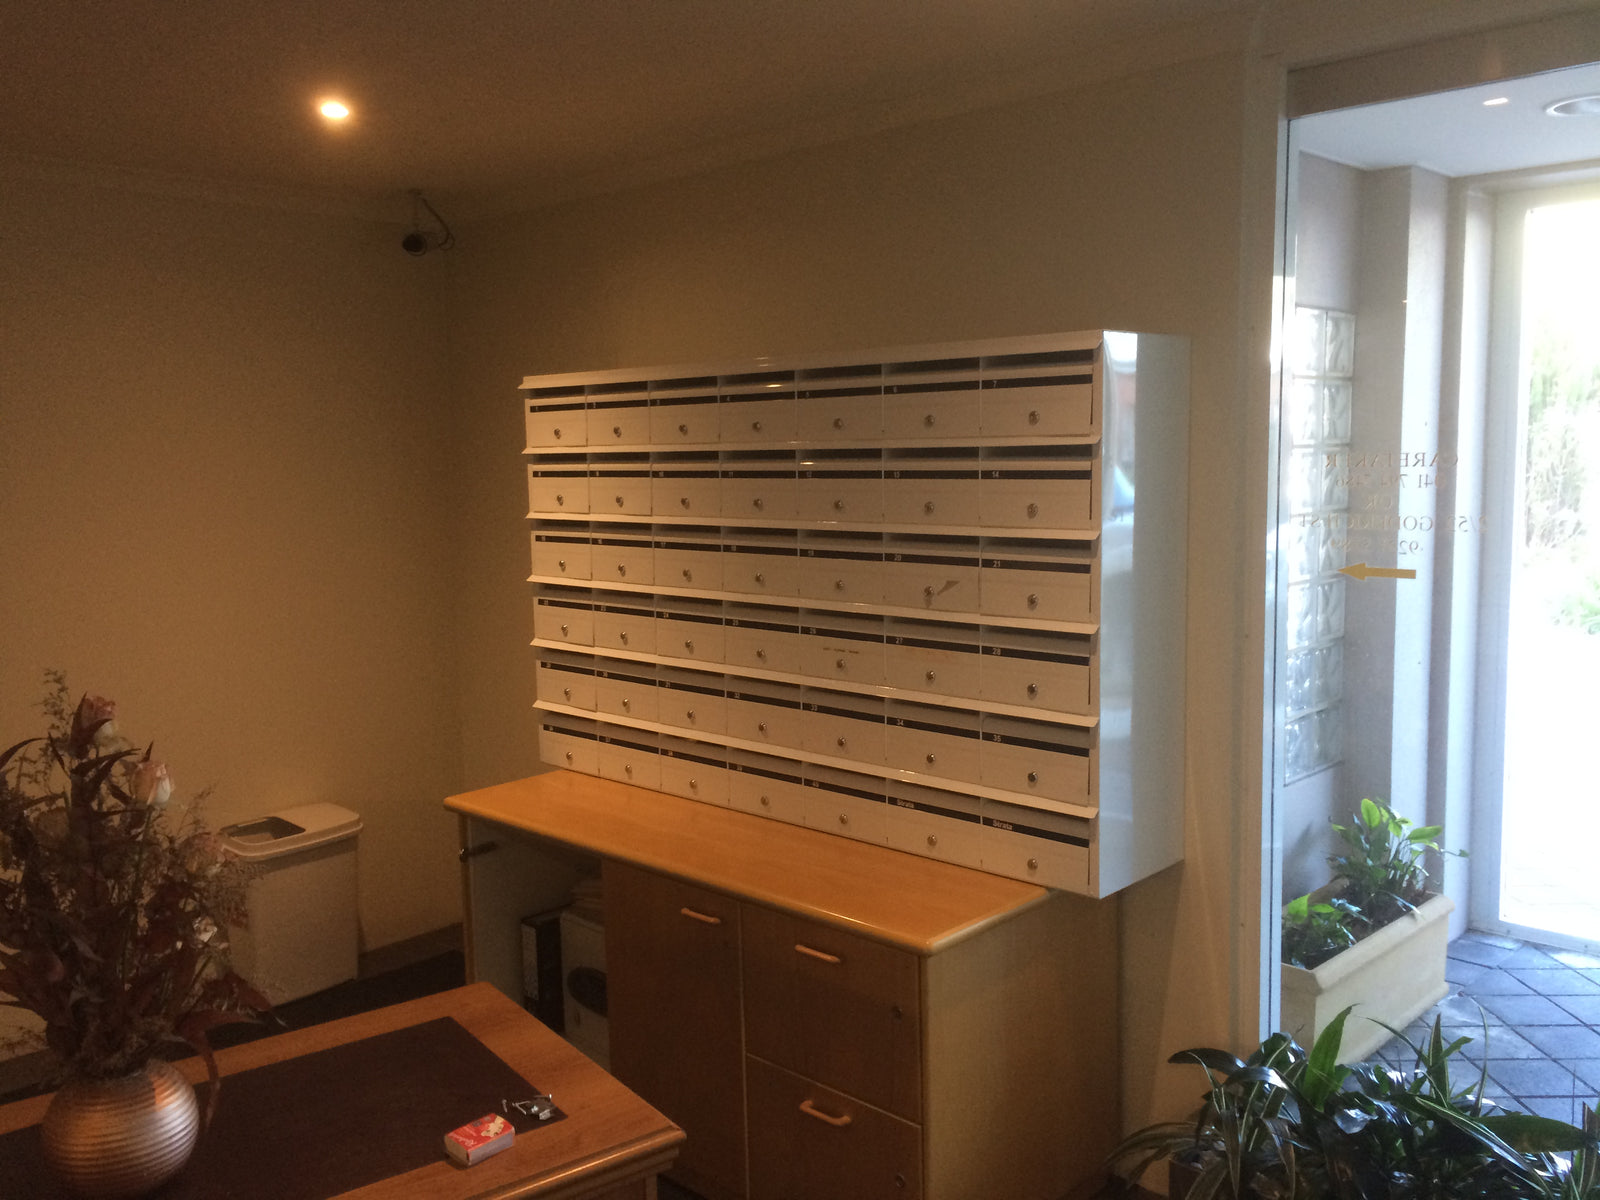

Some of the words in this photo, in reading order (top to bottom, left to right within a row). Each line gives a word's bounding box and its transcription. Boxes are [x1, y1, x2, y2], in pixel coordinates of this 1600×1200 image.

[993, 560, 1001, 568] 21
[993, 734, 1002, 742] 35
[897, 799, 915, 809] Strata
[993, 820, 1013, 830] Strata
